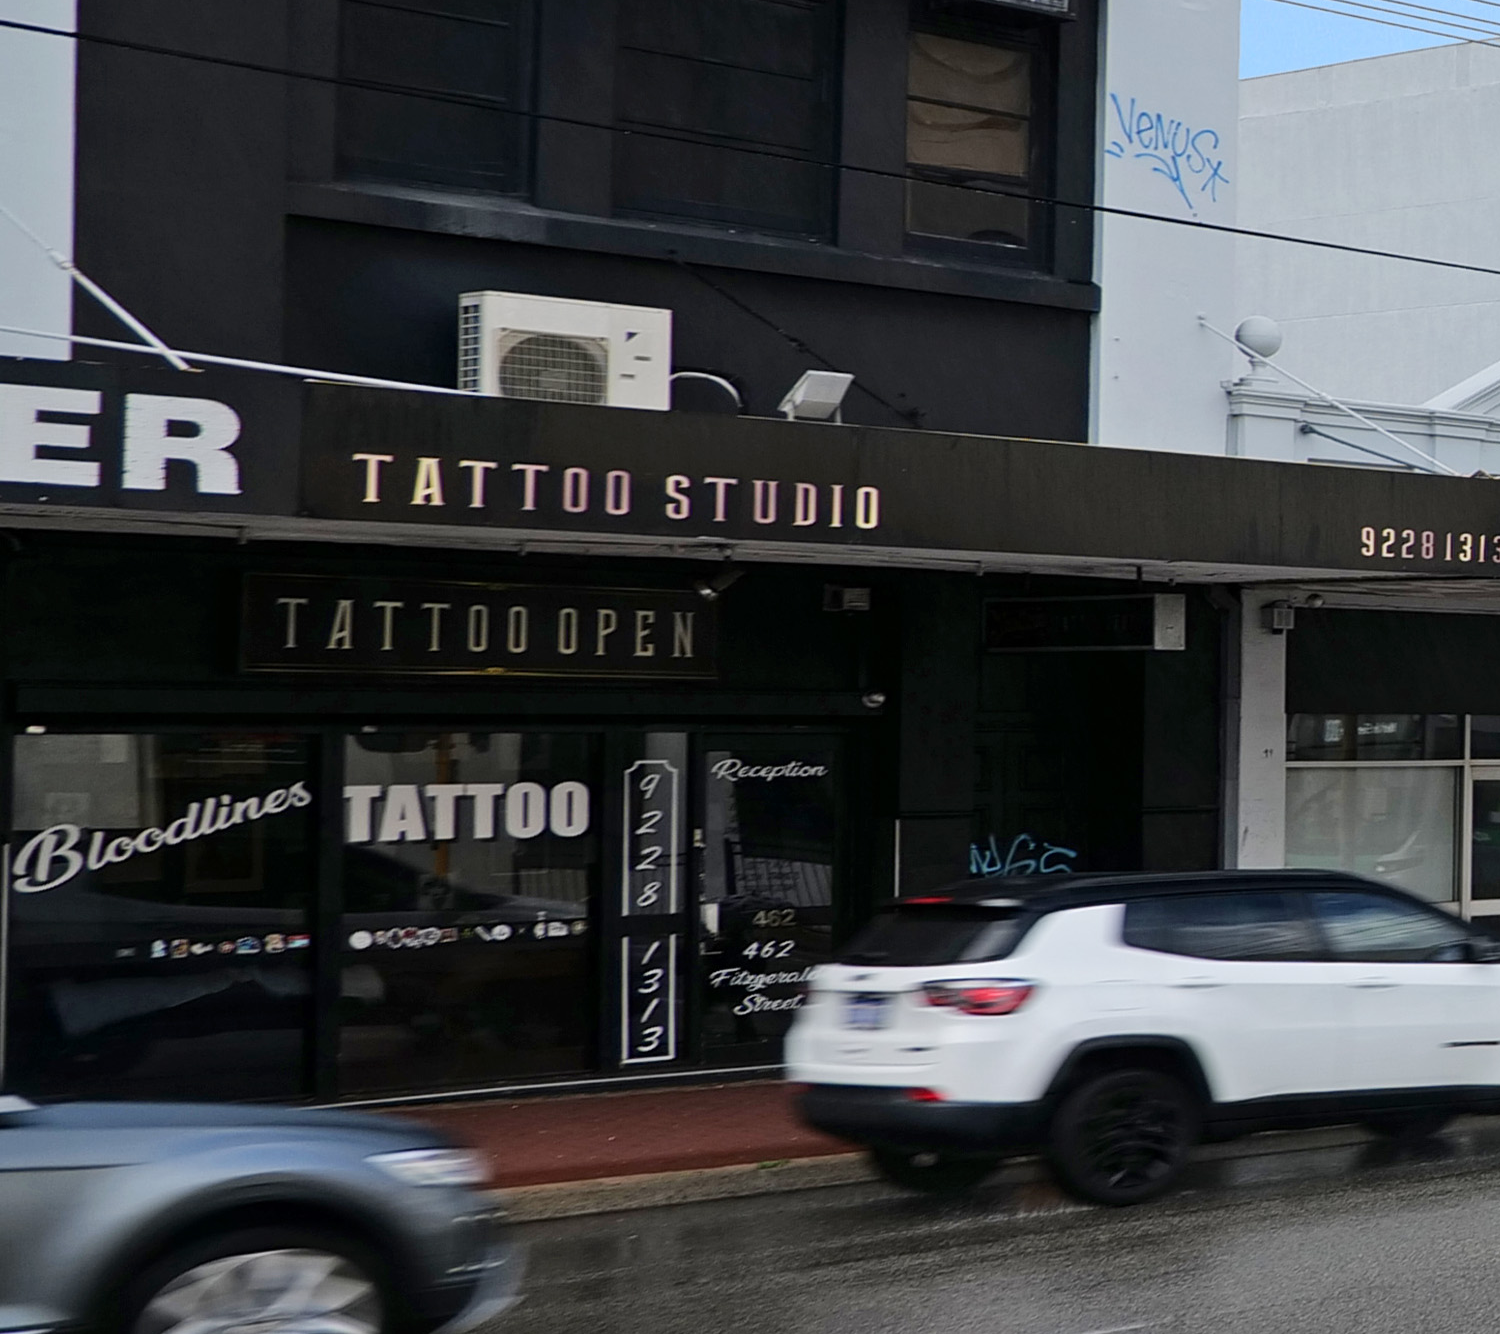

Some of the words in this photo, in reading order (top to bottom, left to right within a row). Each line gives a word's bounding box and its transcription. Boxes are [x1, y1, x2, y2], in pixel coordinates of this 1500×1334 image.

[352, 453, 631, 516] TATTOO
[664, 473, 880, 531] STUDIO
[1361, 526, 1435, 559] 9228
[277, 598, 529, 654] TATTOO
[557, 607, 695, 659] OPEN
[710, 758, 829, 783] Reception
[342, 780, 590, 843] TATTOO
[12, 780, 313, 894] Bloodlines
[752, 908, 797, 929] 462
[742, 939, 796, 960] 462
[733, 993, 803, 1016] Street
